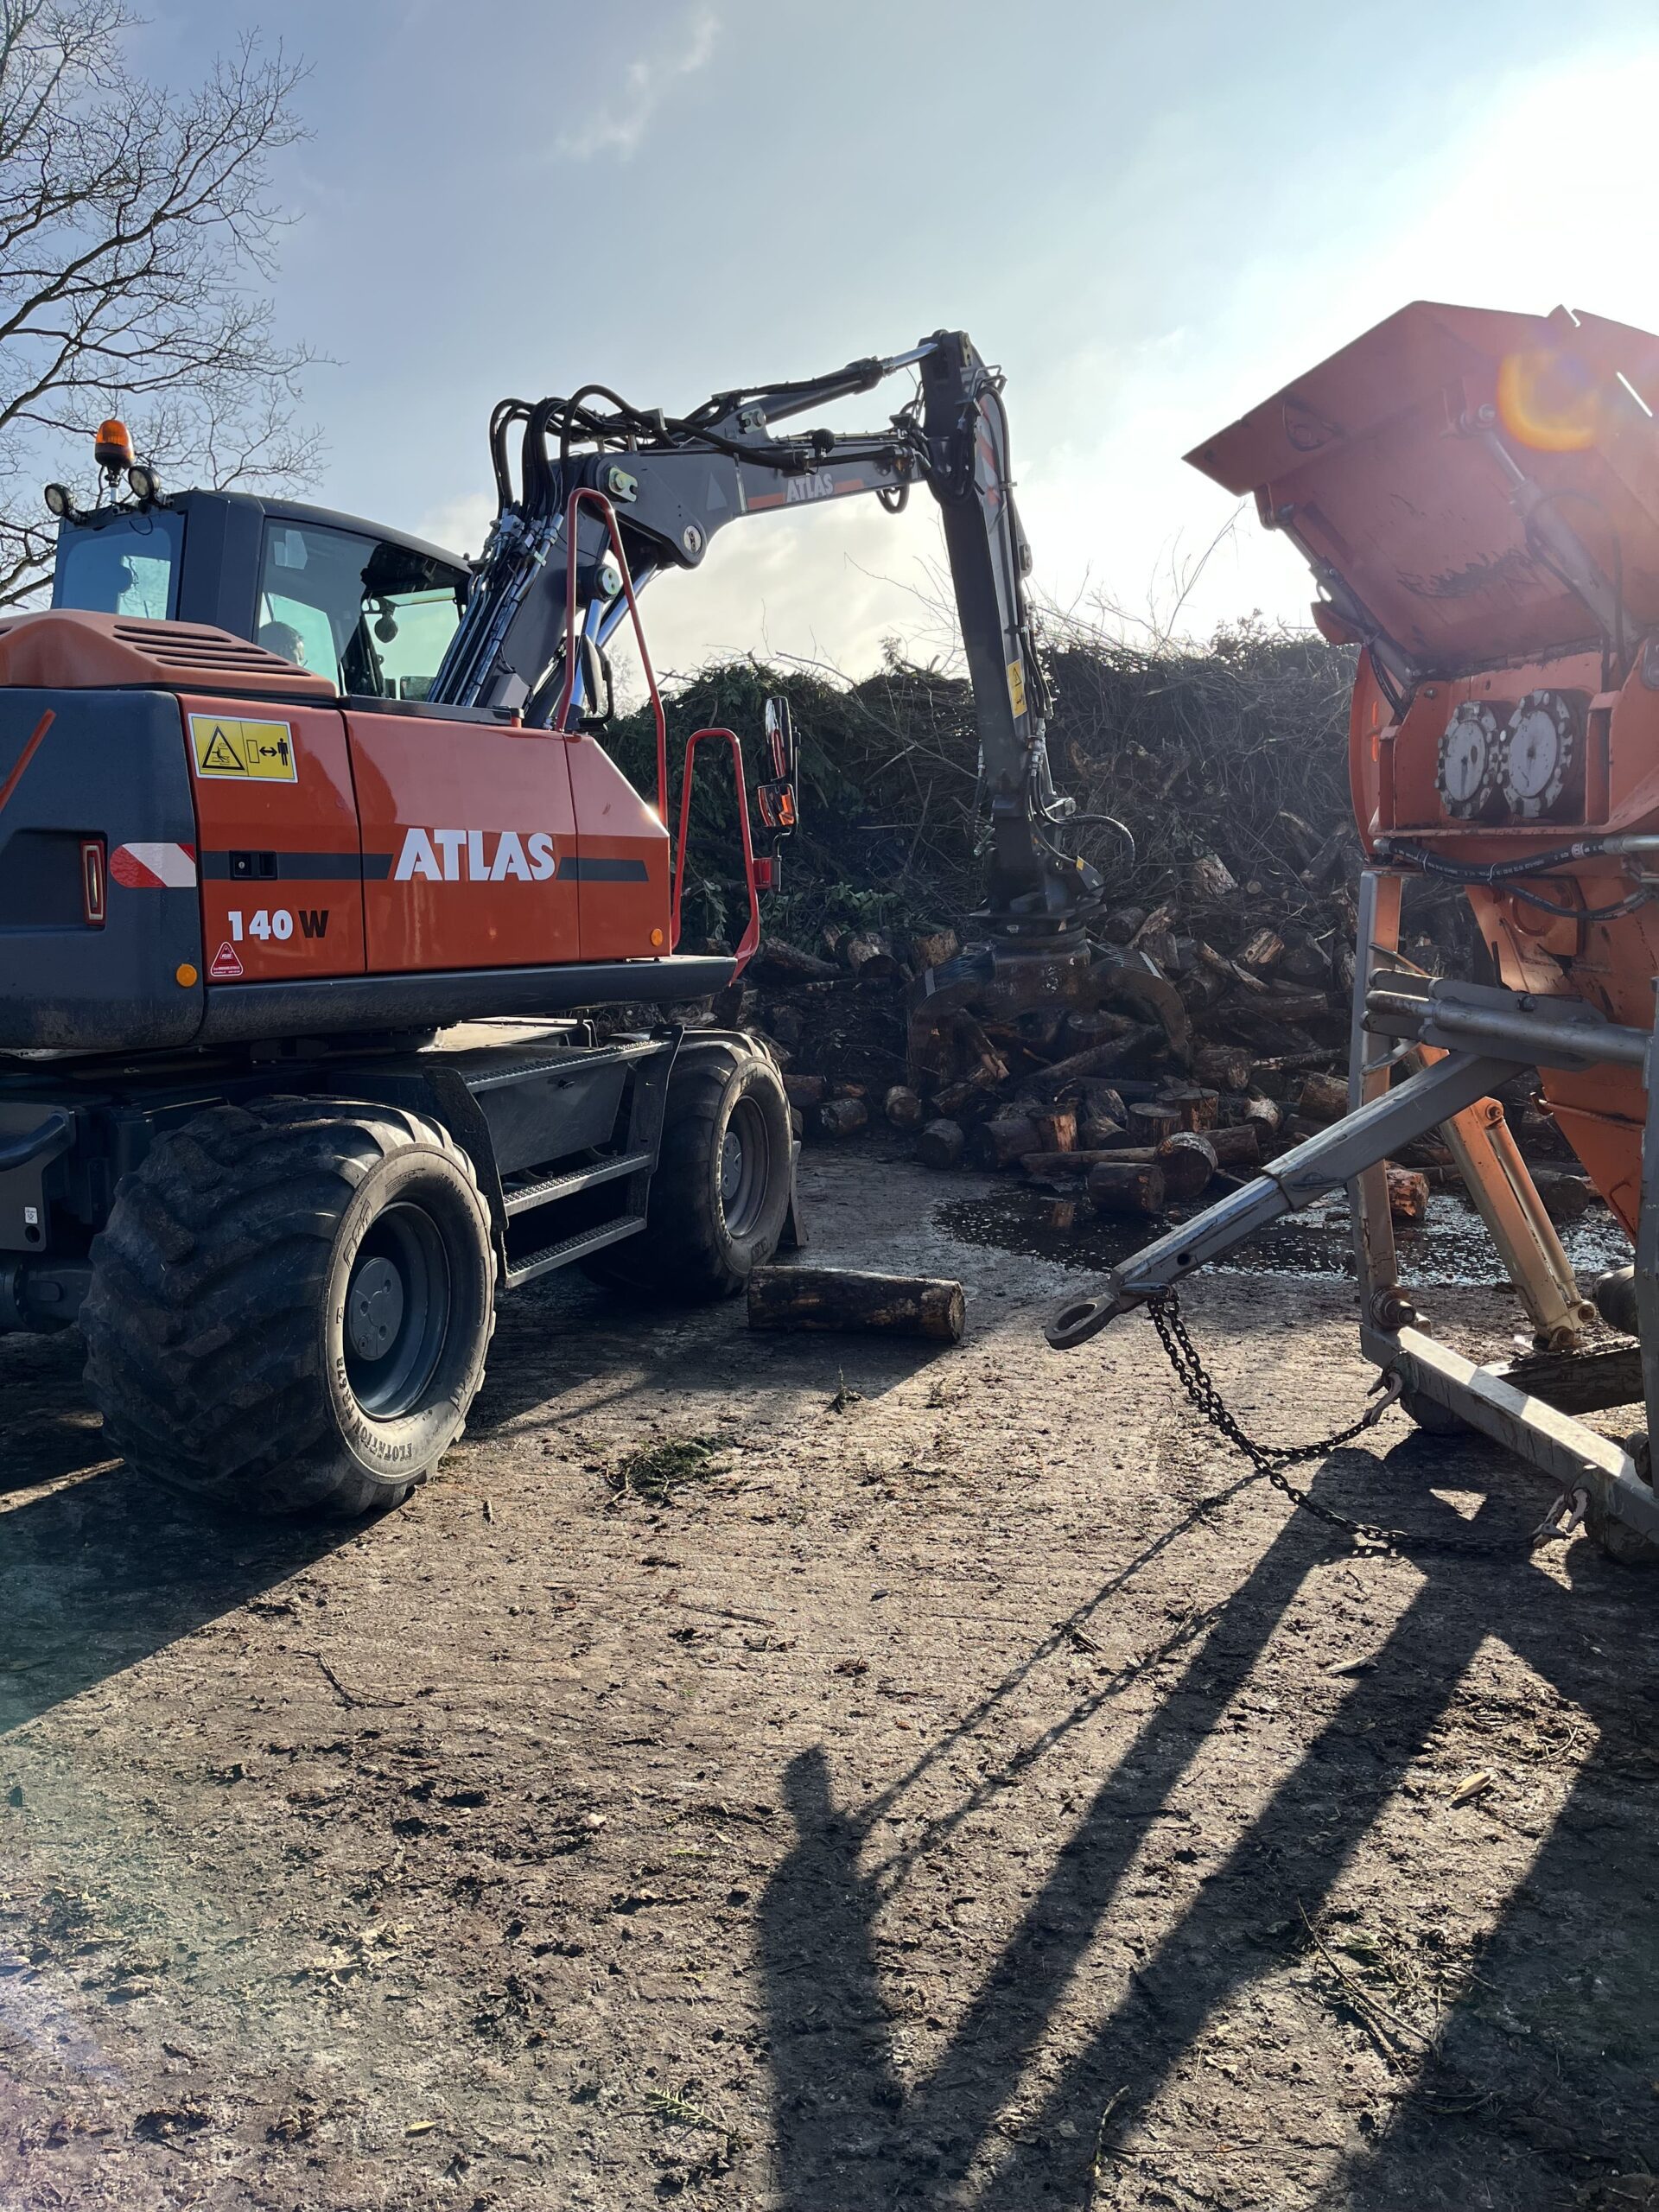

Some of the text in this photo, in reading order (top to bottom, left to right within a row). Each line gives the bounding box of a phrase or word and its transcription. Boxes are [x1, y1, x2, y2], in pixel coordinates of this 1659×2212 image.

[786, 474, 834, 503] ATLAS
[394, 828, 556, 881] ATLAS
[227, 910, 329, 941] 140 W
[352, 1416, 413, 1461] FLOTATION
